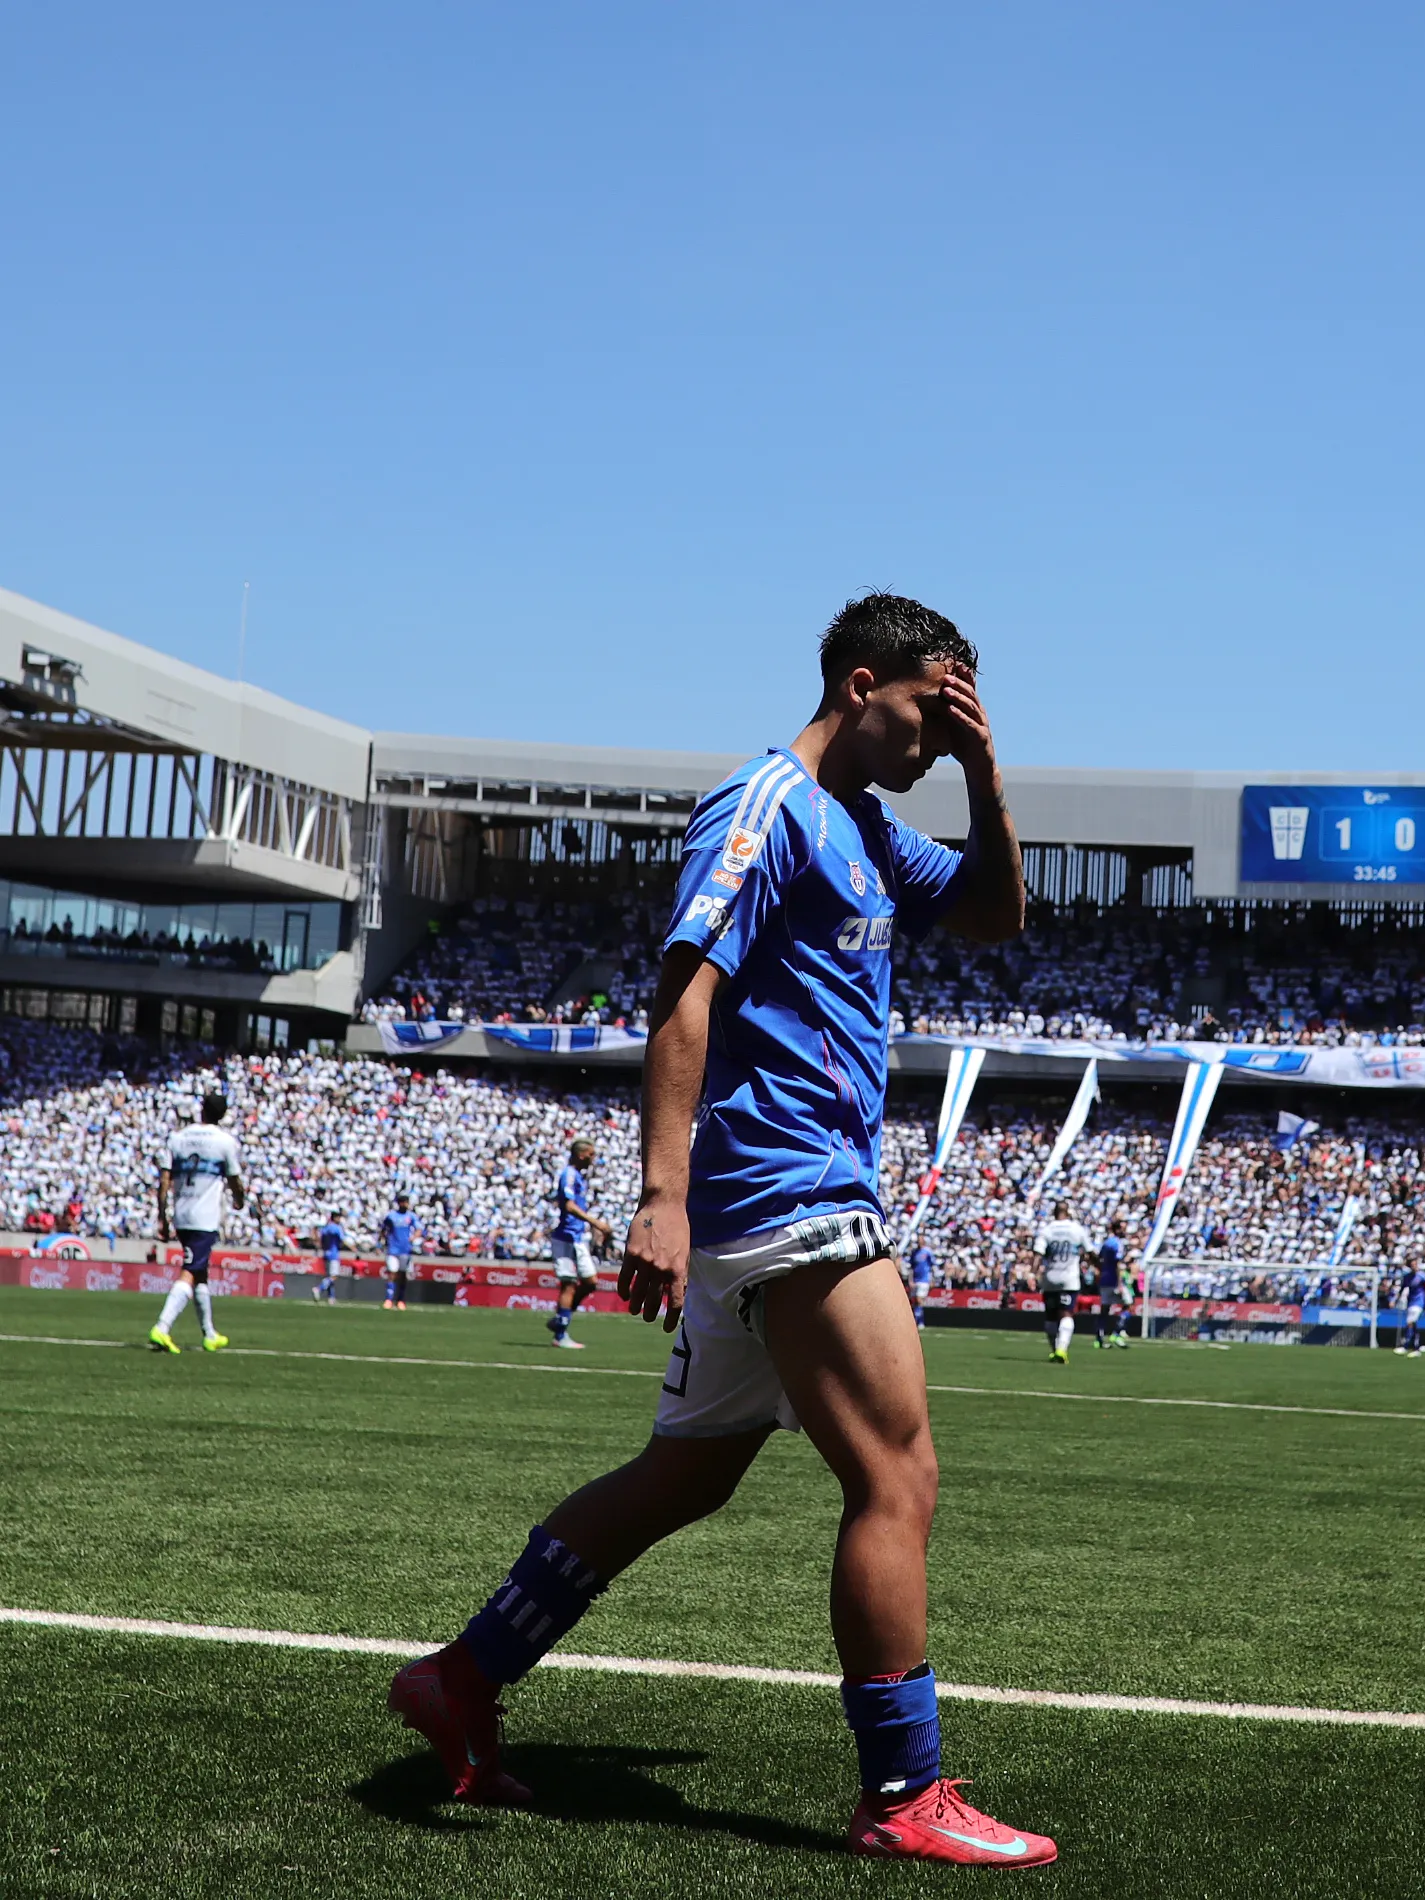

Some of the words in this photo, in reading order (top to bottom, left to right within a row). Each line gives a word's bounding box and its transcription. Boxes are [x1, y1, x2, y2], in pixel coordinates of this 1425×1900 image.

[1336, 817, 1351, 850] 1
[1394, 817, 1415, 851] 0
[1354, 866, 1397, 881] 33:45
[1050, 1240, 1070, 1262] 20
[432, 1269, 464, 1283] Clar
[486, 1271, 523, 1287] Claro
[1248, 1310, 1289, 1323] Claro
